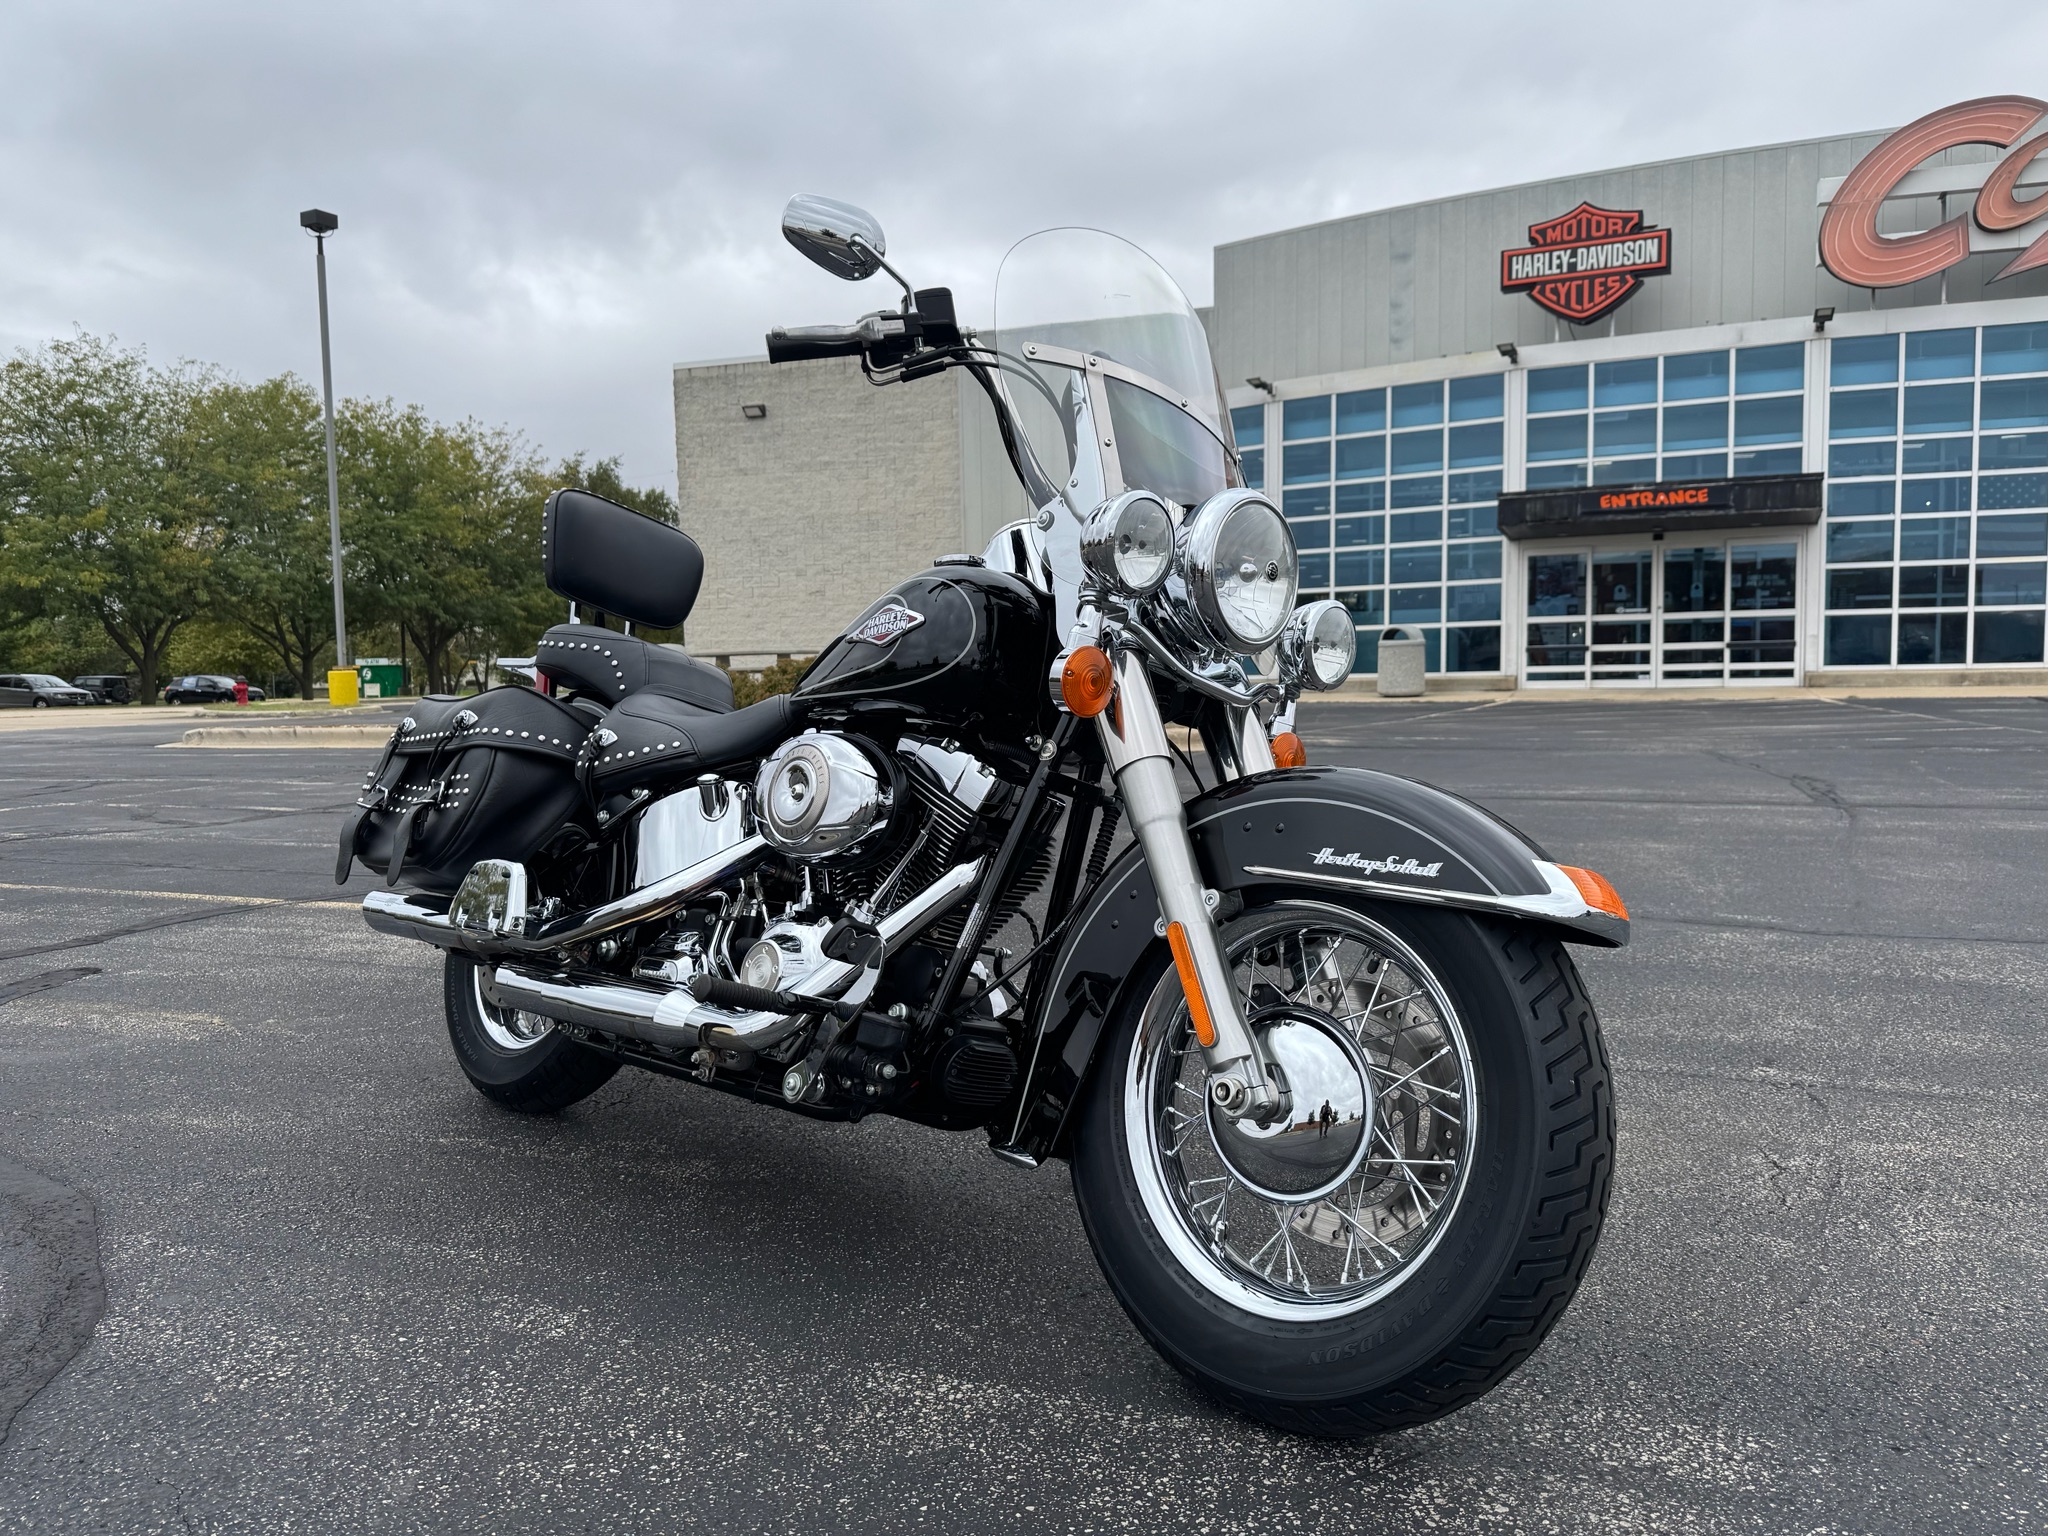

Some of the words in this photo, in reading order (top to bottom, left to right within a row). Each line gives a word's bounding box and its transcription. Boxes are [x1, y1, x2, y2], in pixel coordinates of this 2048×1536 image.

[1546, 212, 1623, 244] MOTOR
[1511, 238, 1659, 280] HARLEY-DAVIDSON
[1545, 275, 1621, 311] CYCLES
[1600, 488, 1709, 508] ENTRANCE
[863, 619, 908, 638] DAVIDSON
[1453, 1149, 1504, 1276] HARLEY
[1307, 1299, 1433, 1365] DAVIDSON
